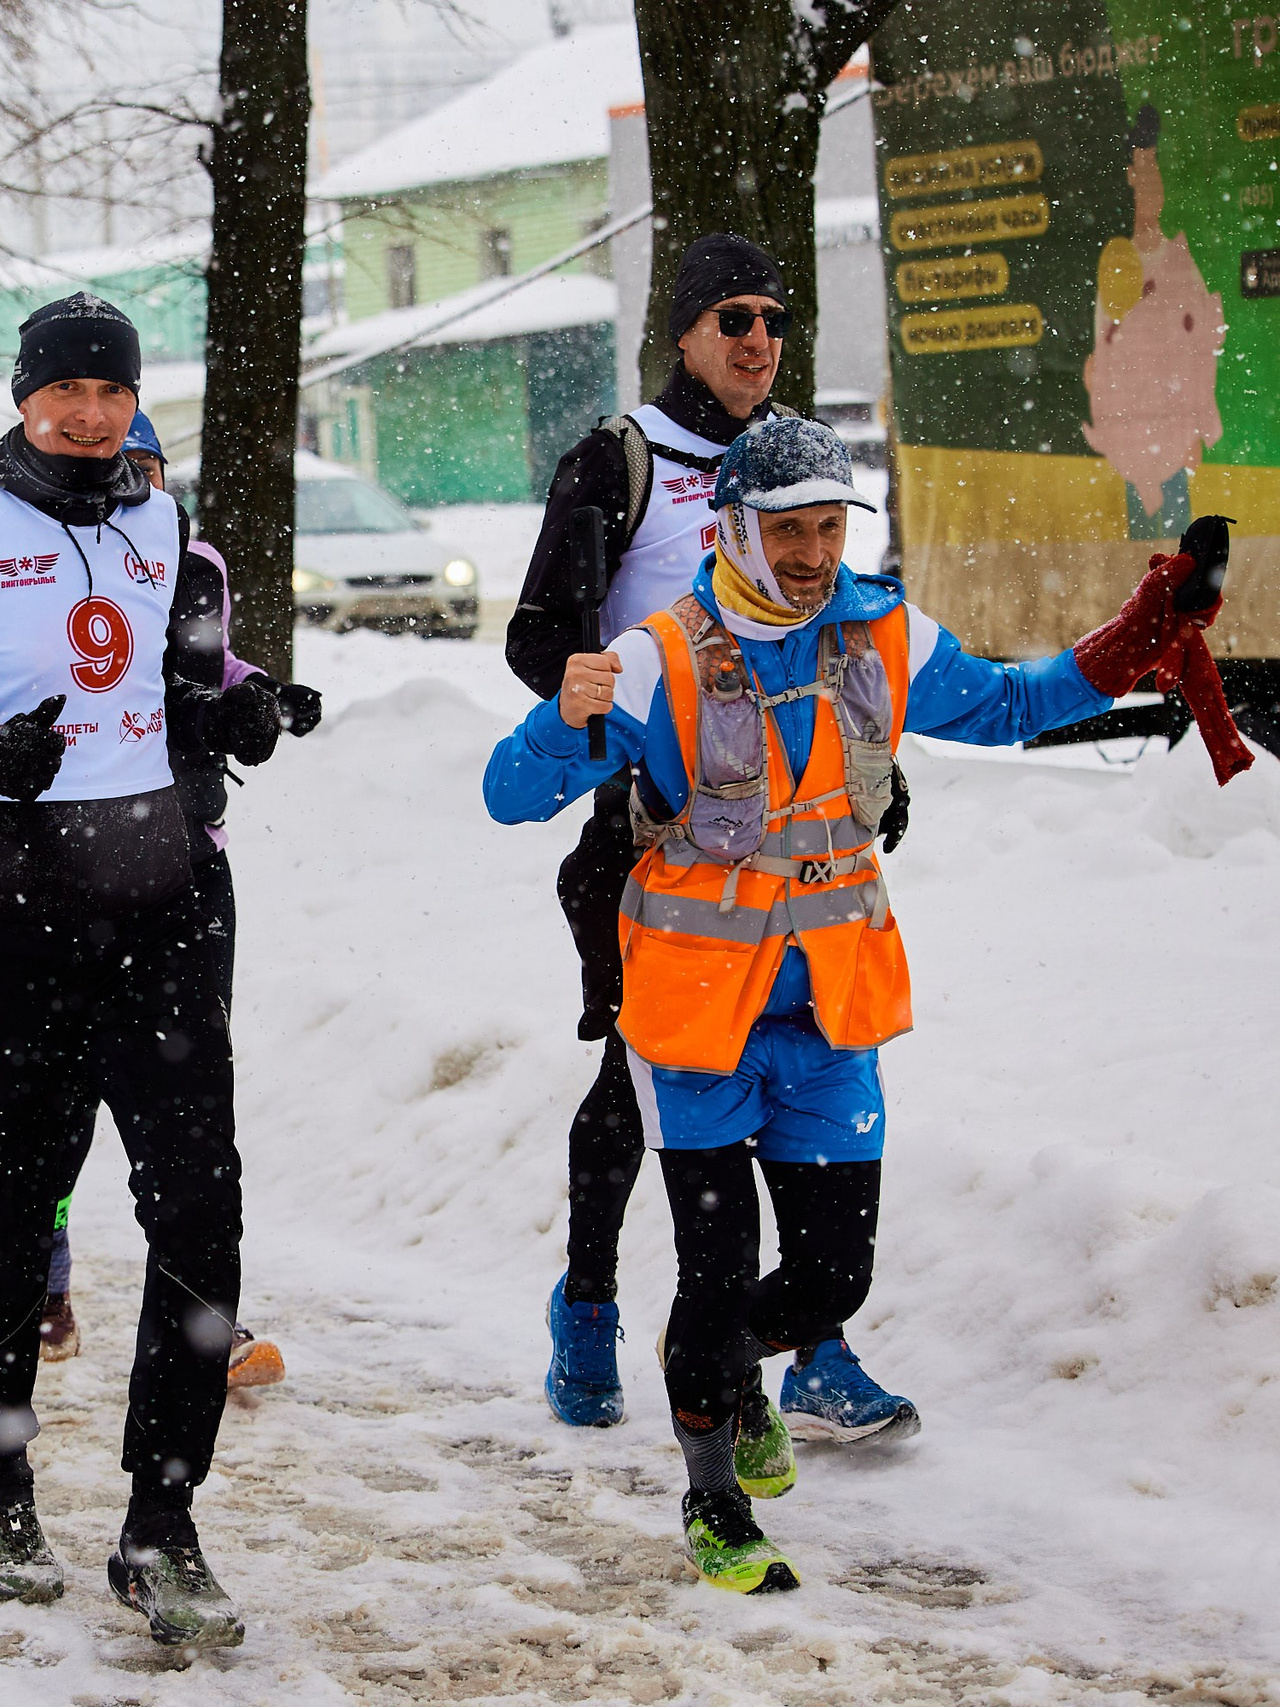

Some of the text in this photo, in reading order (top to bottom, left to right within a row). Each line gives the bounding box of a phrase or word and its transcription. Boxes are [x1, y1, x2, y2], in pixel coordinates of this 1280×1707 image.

[1003, 54, 1054, 87] ваш
[1058, 34, 1162, 79] бюджет
[1238, 184, 1273, 210] (495)
[1001, 208, 1041, 229] часы
[907, 315, 1038, 344] ночью дешевле
[0, 575, 57, 589] ВИНТОКРЫЛЫЕ
[67, 595, 135, 694] 9
[51, 722, 99, 735] ТОЛЕТЫ
